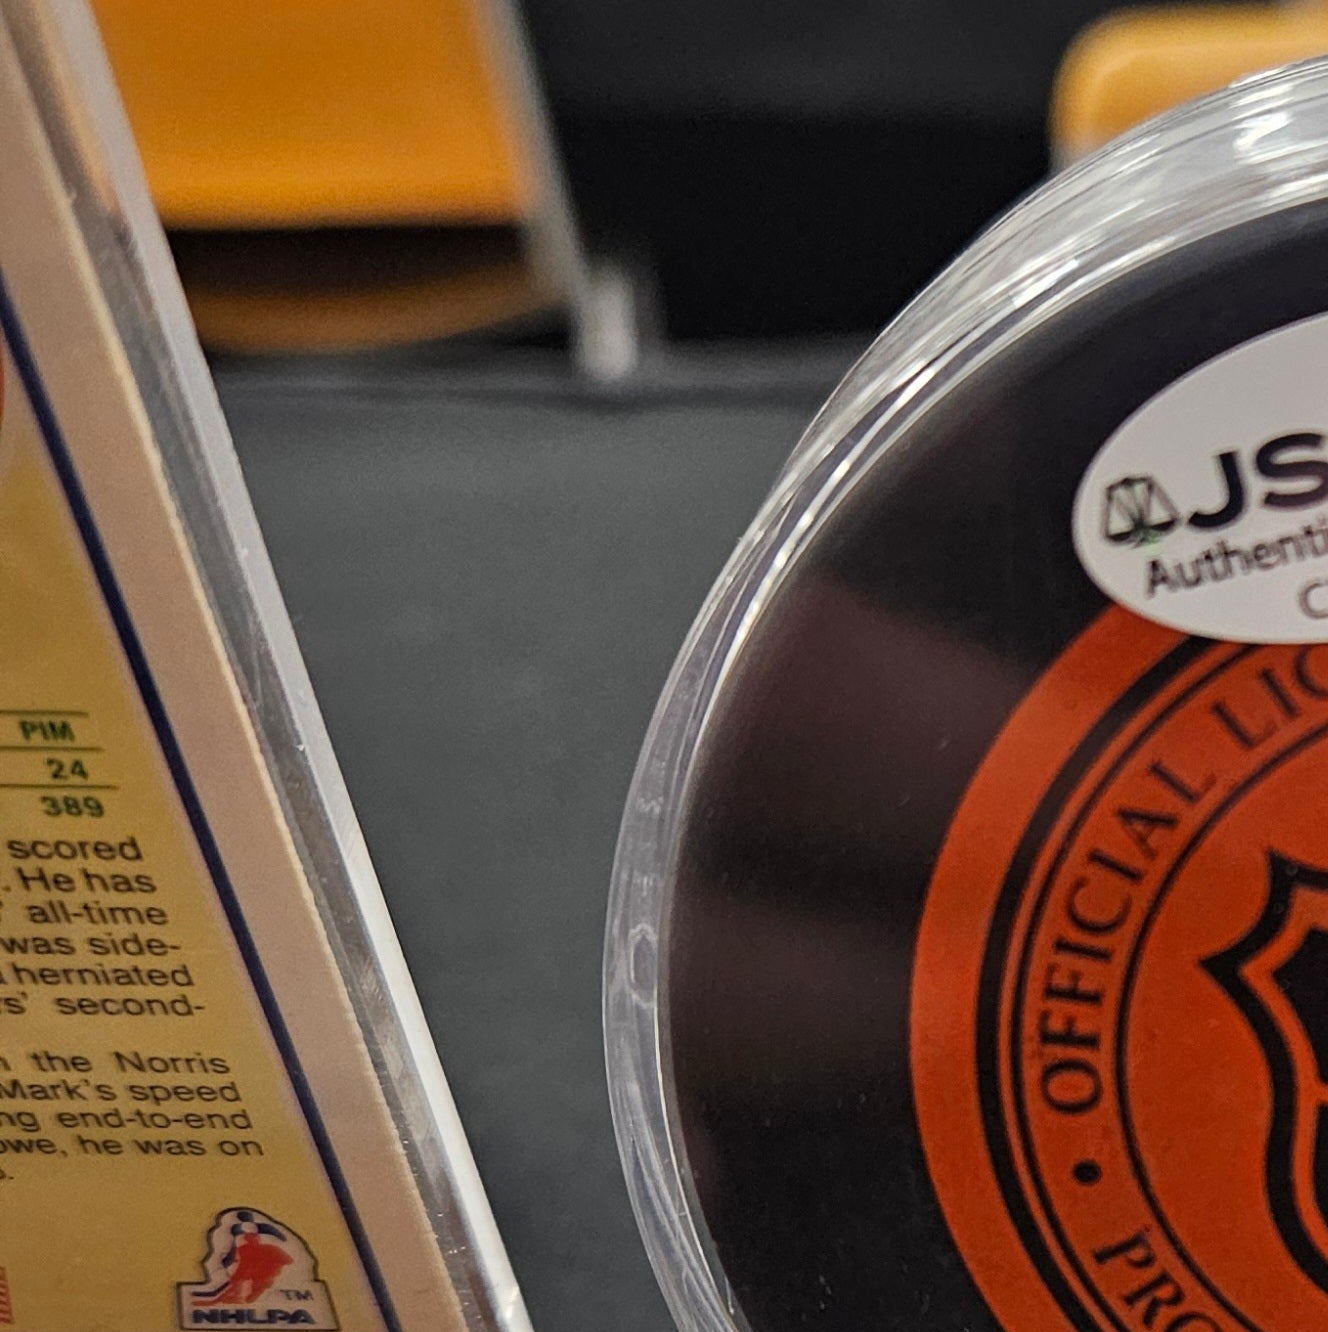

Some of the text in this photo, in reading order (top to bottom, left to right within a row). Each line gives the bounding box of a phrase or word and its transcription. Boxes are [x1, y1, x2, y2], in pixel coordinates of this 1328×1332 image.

[19, 719, 76, 742] PIM
[46, 757, 89, 781] 24
[40, 795, 105, 818] 389
[7, 835, 144, 861] scored
[16, 867, 157, 894] He has
[27, 901, 169, 926] all-time
[0, 932, 182, 957] was side-
[1037, 760, 1216, 1116] OFFICIAL
[10, 962, 195, 987] herniated
[55, 993, 206, 1017] second-
[30, 1050, 93, 1073] the
[113, 1050, 231, 1075] Norris
[0, 1078, 242, 1106] Mark's speed
[55, 1107, 254, 1131] end-to-end
[77, 1134, 124, 1156] he
[133, 1139, 207, 1157] was
[217, 1139, 265, 1156] on
[192, 1308, 317, 1325] NHLPA
